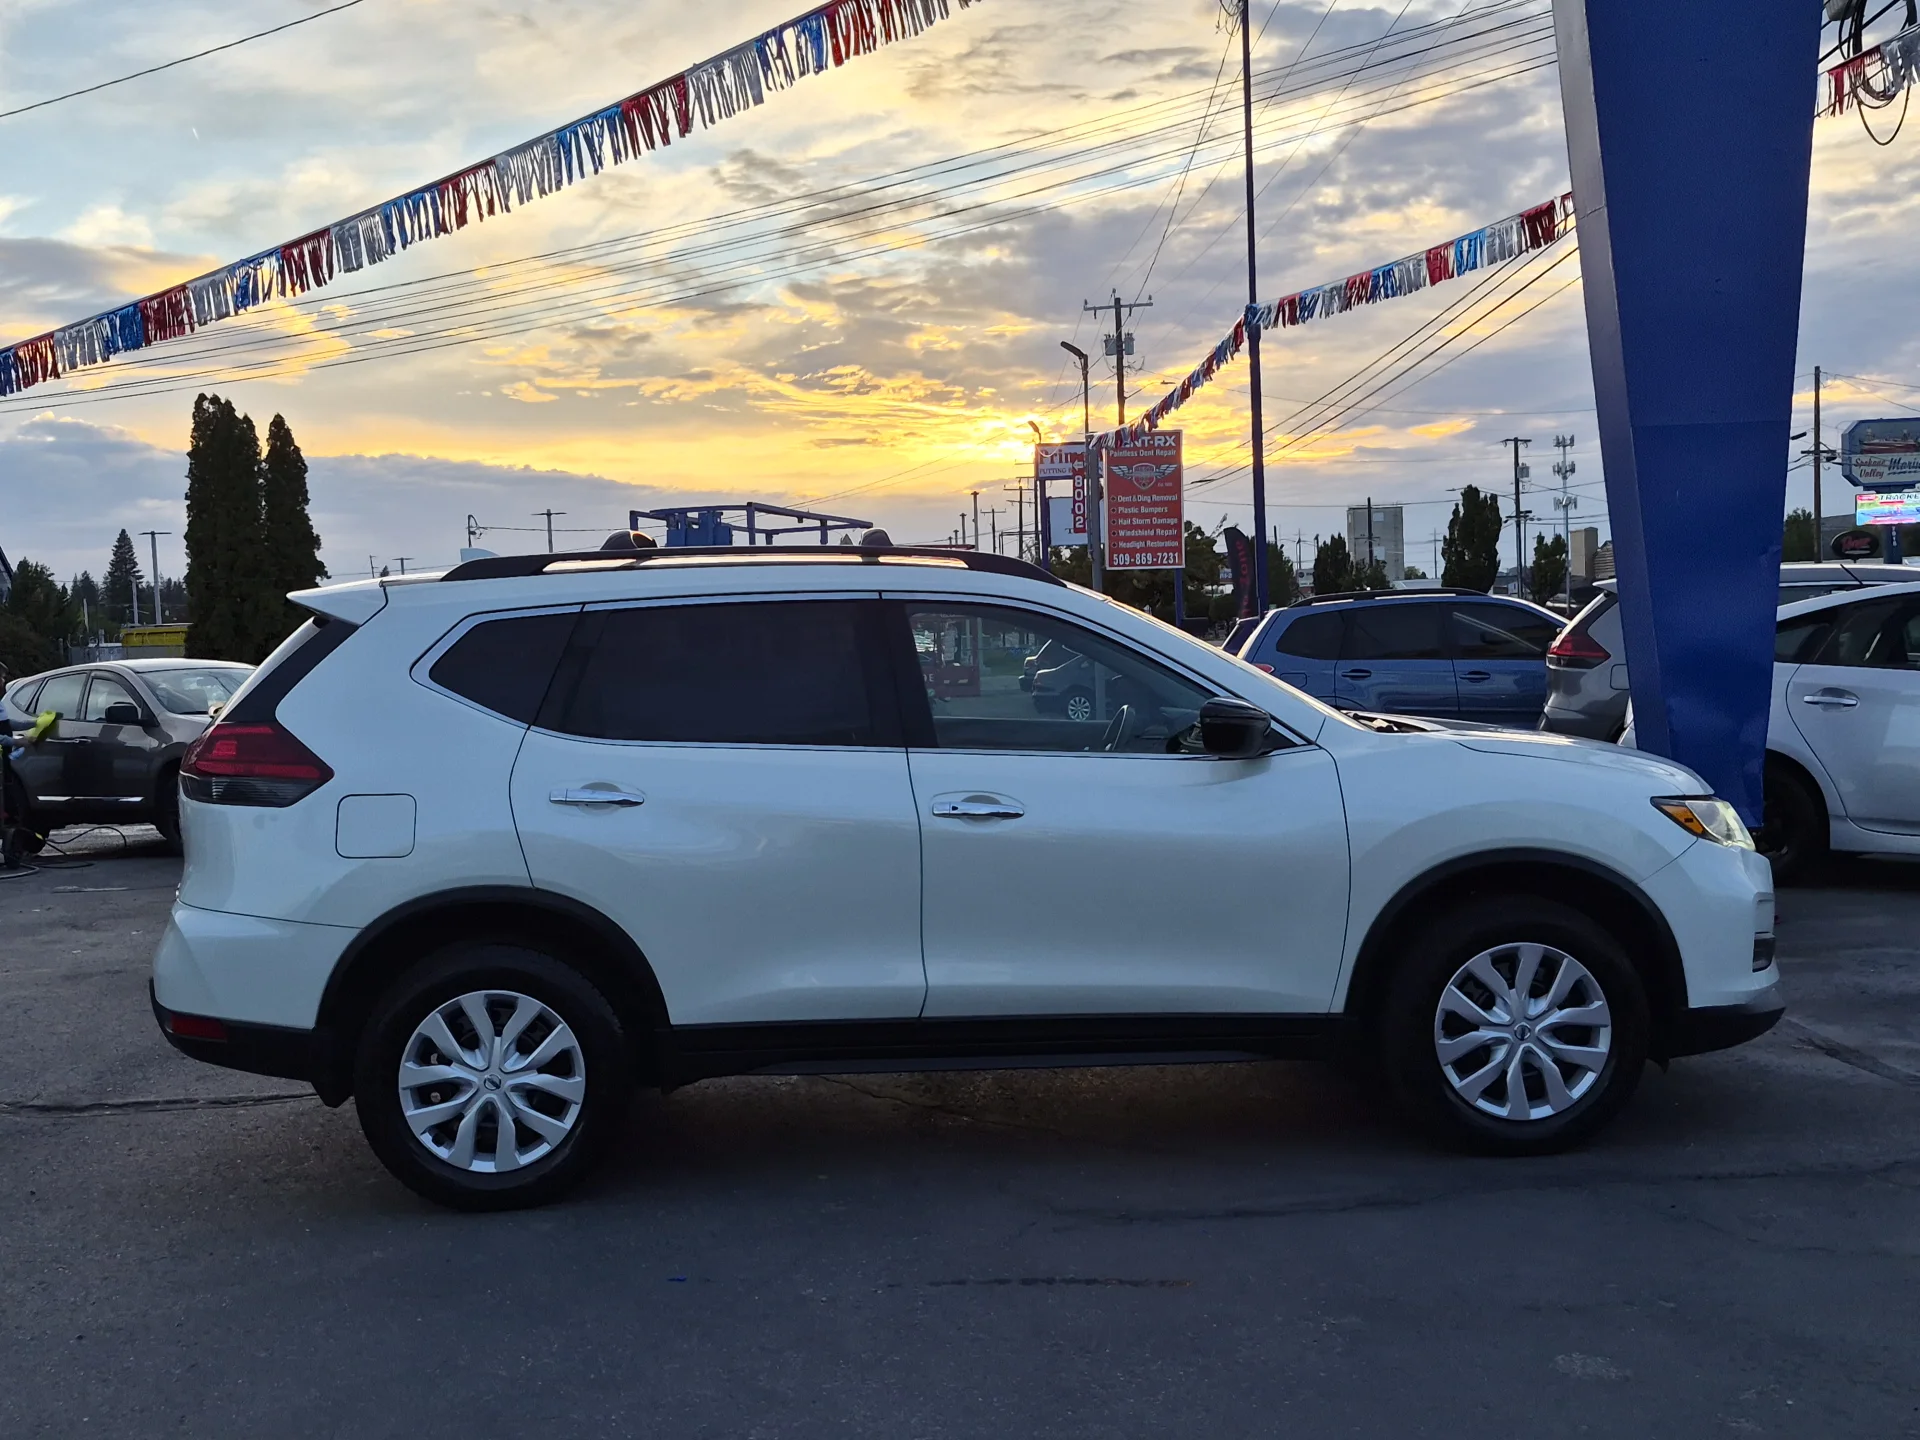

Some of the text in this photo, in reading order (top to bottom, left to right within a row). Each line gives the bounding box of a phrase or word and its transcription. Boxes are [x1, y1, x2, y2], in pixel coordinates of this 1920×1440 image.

[1121, 435, 1177, 448] ENT-RX
[1139, 449, 1154, 457] Dent
[1155, 449, 1177, 458] Repair
[1860, 468, 1884, 479] Valley
[1074, 474, 1085, 528] 8002
[1137, 494, 1151, 503] Ding
[1151, 494, 1178, 502] Removal
[1118, 506, 1168, 514] Plastic Bumpers
[1118, 516, 1178, 525] Hail Storm Damage
[1118, 528, 1177, 537] Windshield Repair
[1118, 540, 1179, 549] Headlight Restoration
[1113, 552, 1179, 566] 509-869-7231
